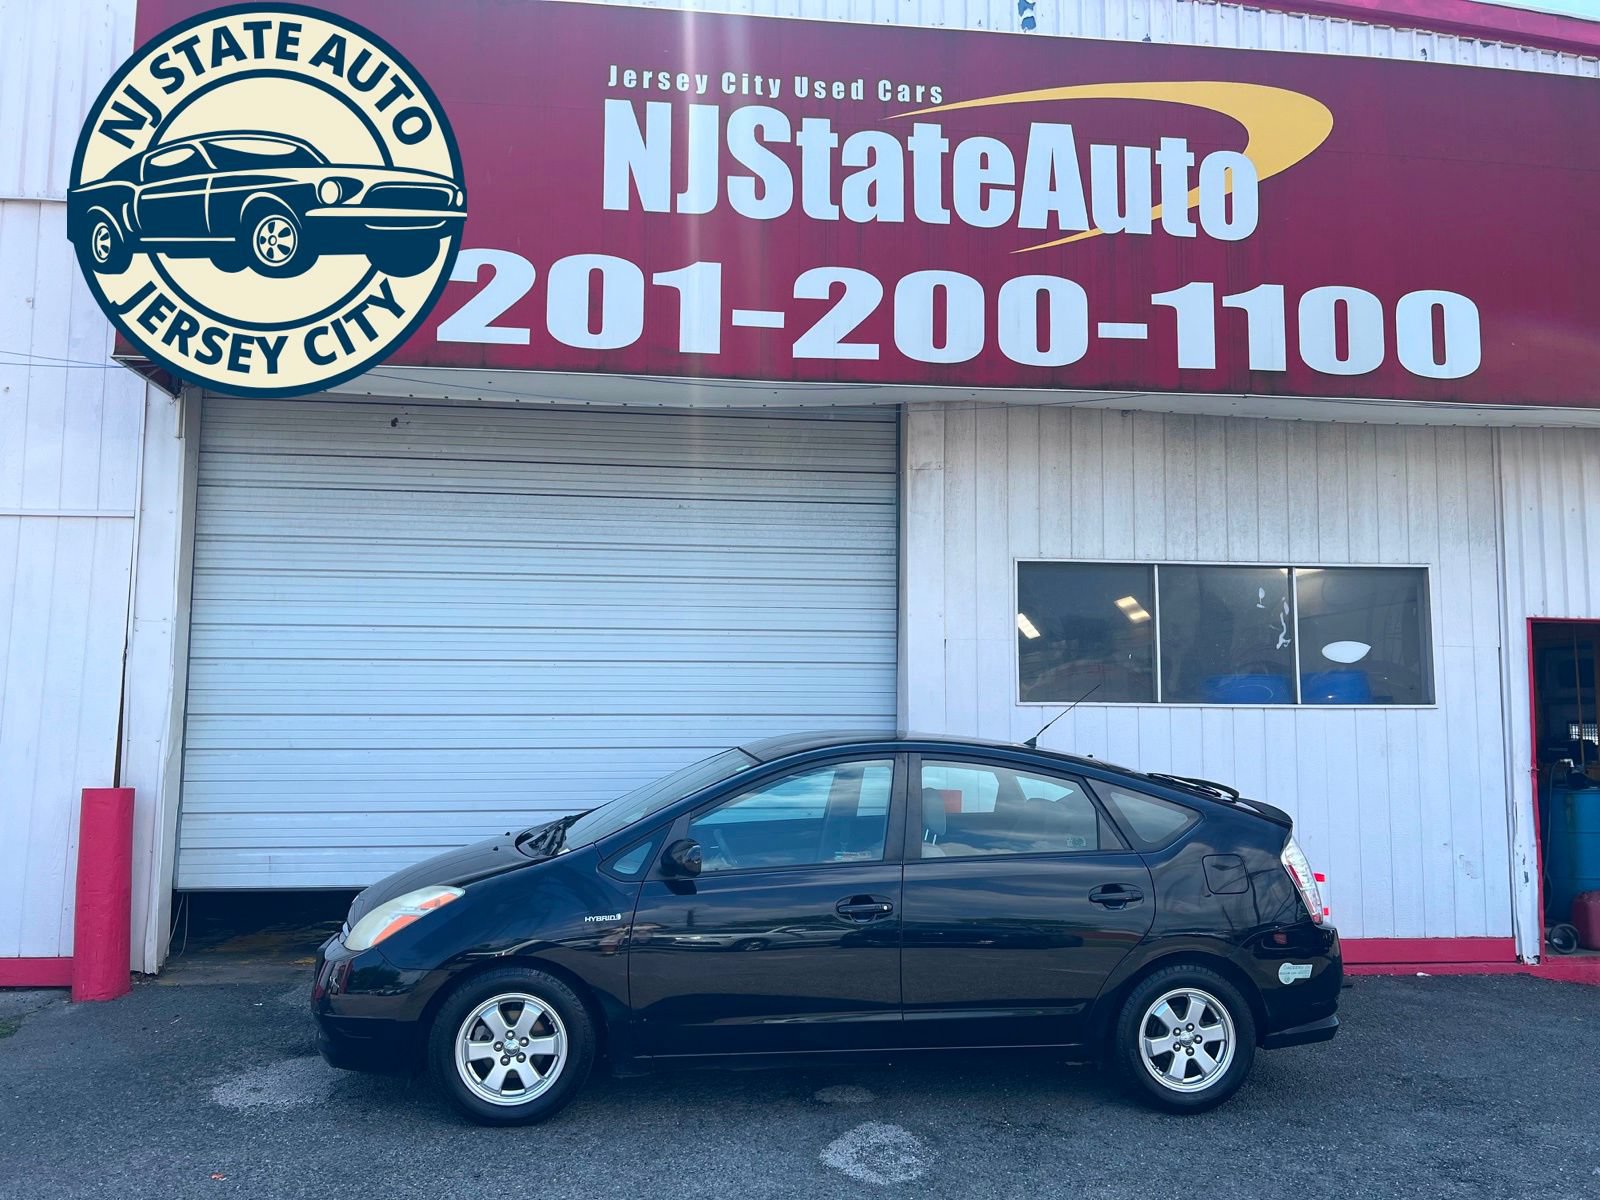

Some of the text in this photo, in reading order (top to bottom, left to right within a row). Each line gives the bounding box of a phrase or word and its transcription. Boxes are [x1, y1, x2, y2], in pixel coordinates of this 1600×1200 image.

[608, 65, 943, 104] Jersey City Used Cars
[603, 99, 1259, 242] NJStateAuto
[437, 248, 1481, 379] 201-200-1100
